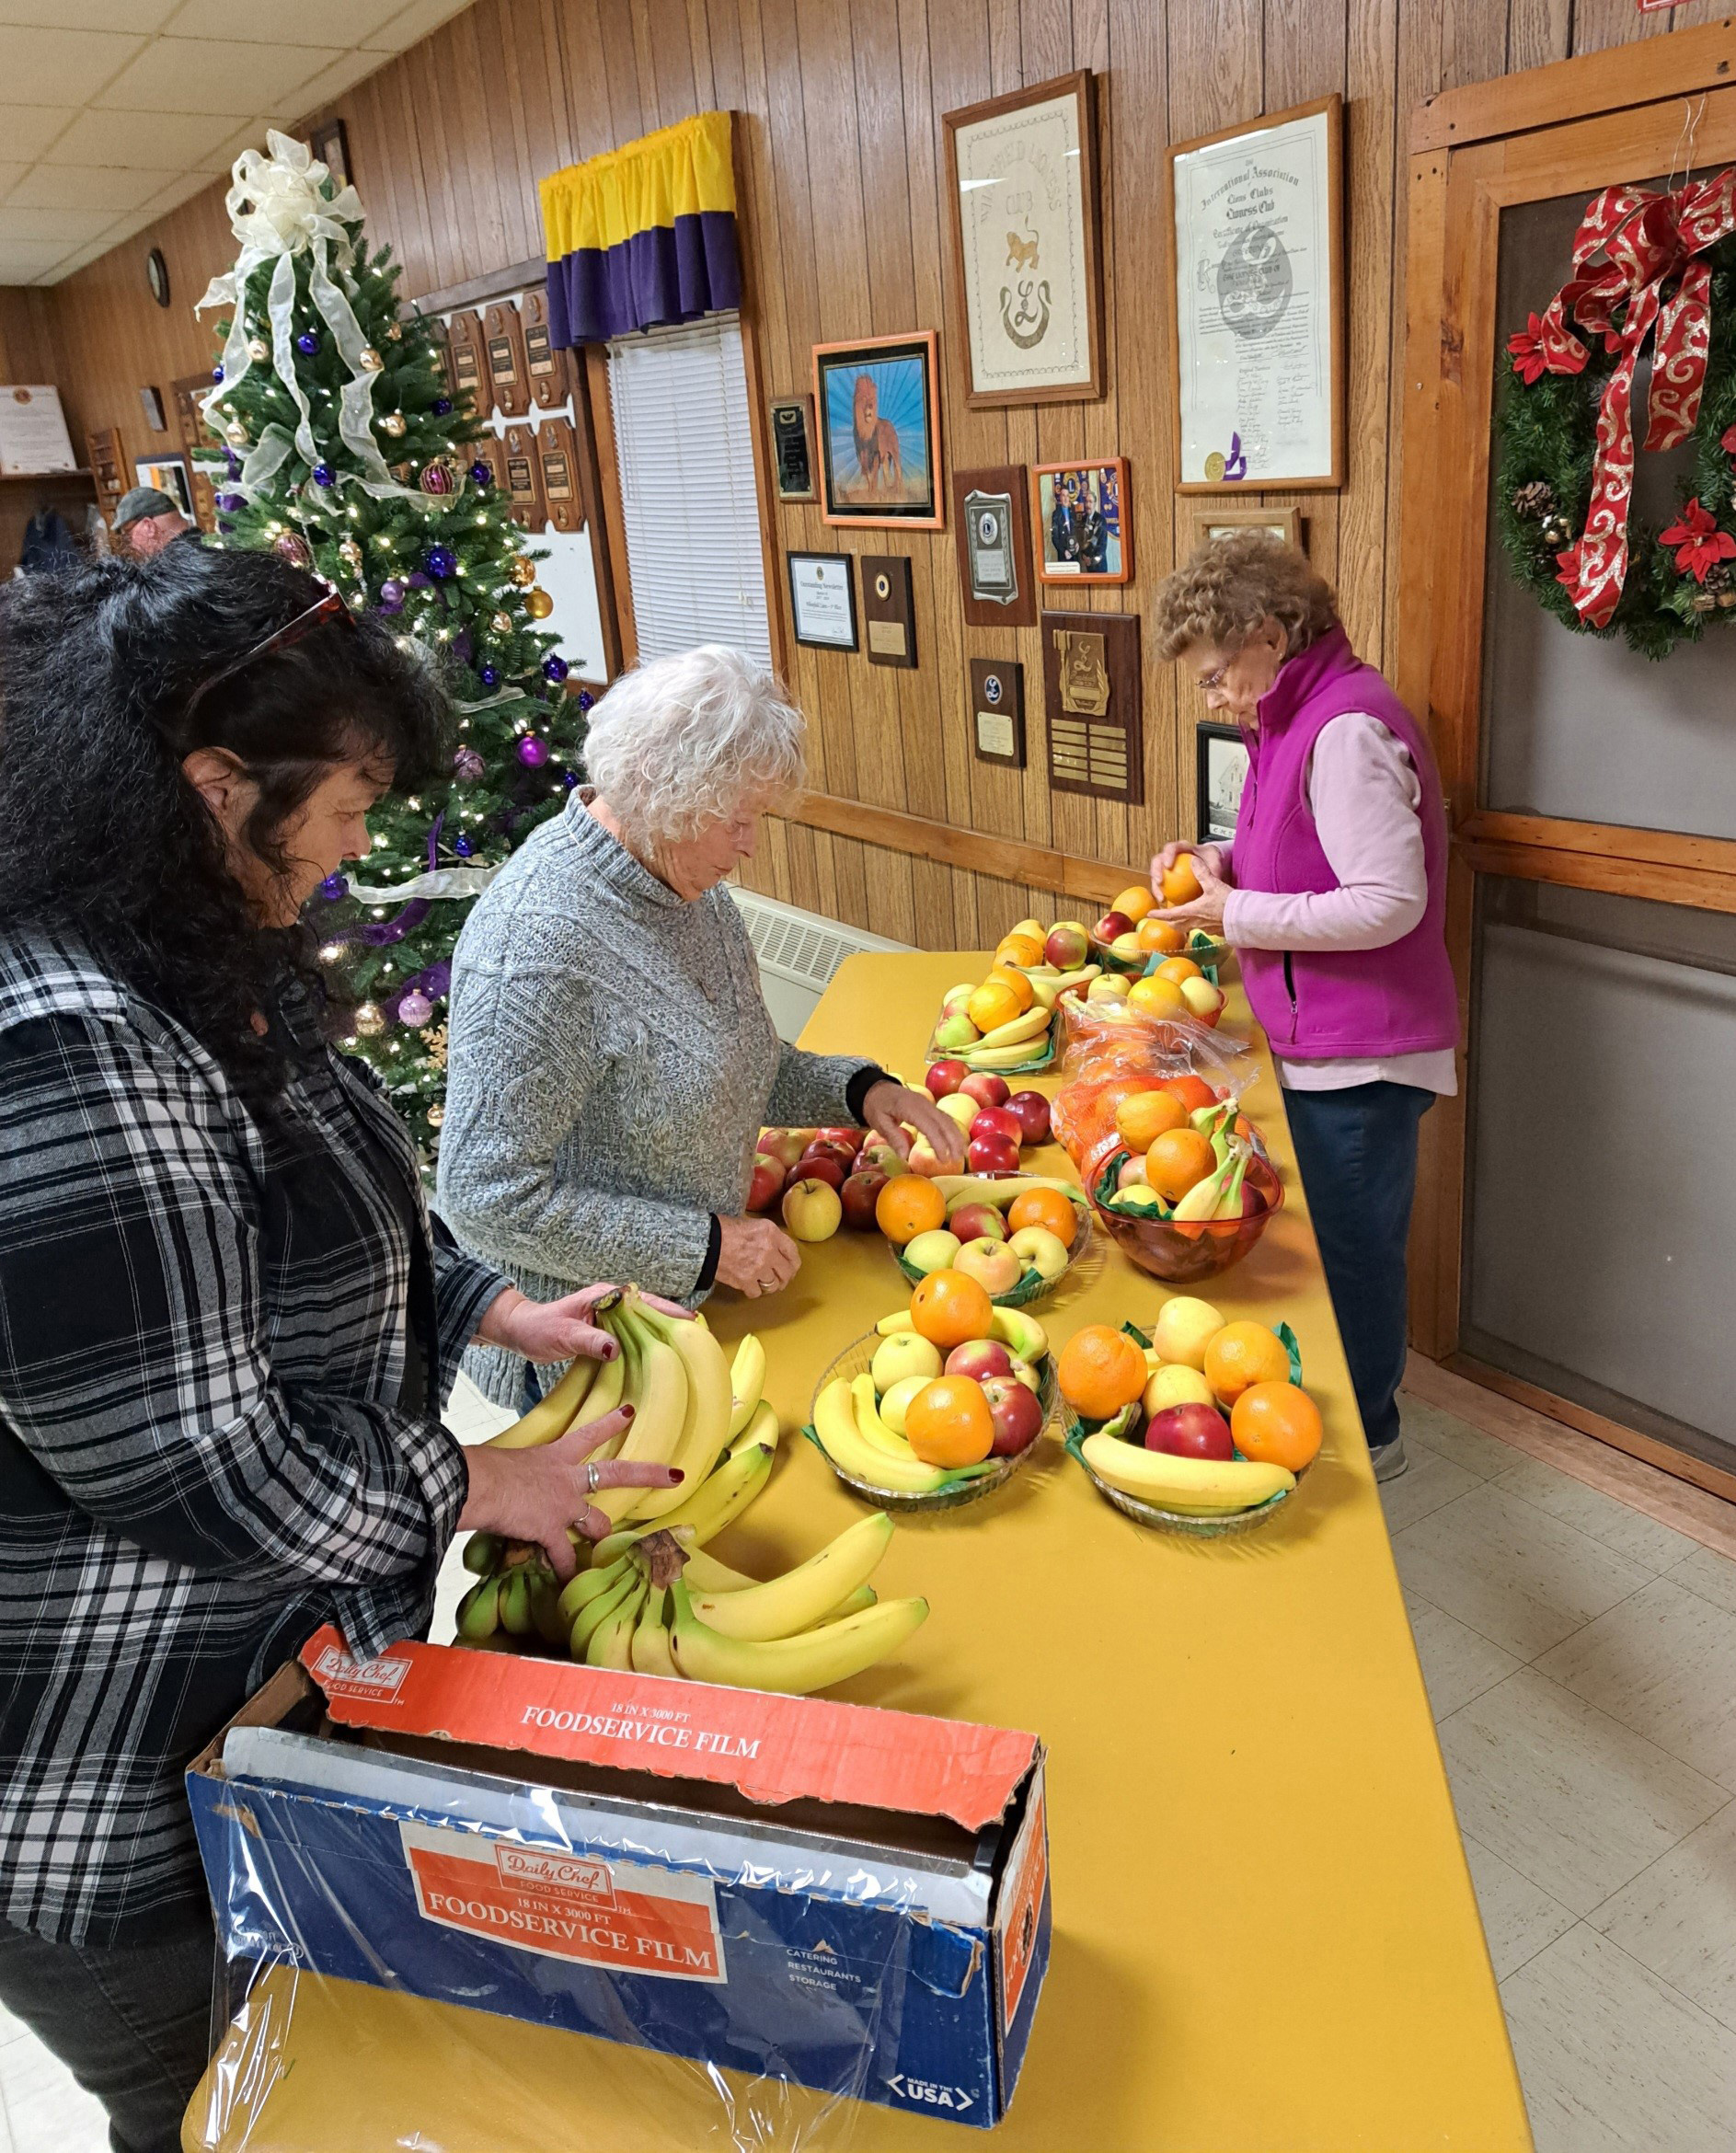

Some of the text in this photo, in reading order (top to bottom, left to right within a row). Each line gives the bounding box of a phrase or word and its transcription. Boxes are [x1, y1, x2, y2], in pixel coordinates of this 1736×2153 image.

[1201, 166, 1299, 211] International Association
[1250, 186, 1273, 199] Clubs
[1259, 200, 1275, 213] Club
[362, 1664, 400, 1685] Chef
[349, 1685, 385, 1698] SERVICE
[611, 1702, 691, 1723] 18 IN X 3000 FT
[521, 1705, 762, 1759] FOODSERVICE FILM
[507, 1855, 600, 1889] Daily Chef
[520, 1881, 599, 1903] FOOD SERVICE
[517, 1897, 611, 1925] 18 IN X 3000 FT
[428, 1892, 713, 1970] FOODSERVICE FILM
[786, 1949, 838, 1965] CATERING
[788, 1961, 862, 1983] RESTAURANTS
[788, 1974, 837, 1991] STORAGE
[907, 2078, 928, 2088] MADE
[938, 2085, 954, 2093] THE
[907, 2083, 954, 2107] USA
